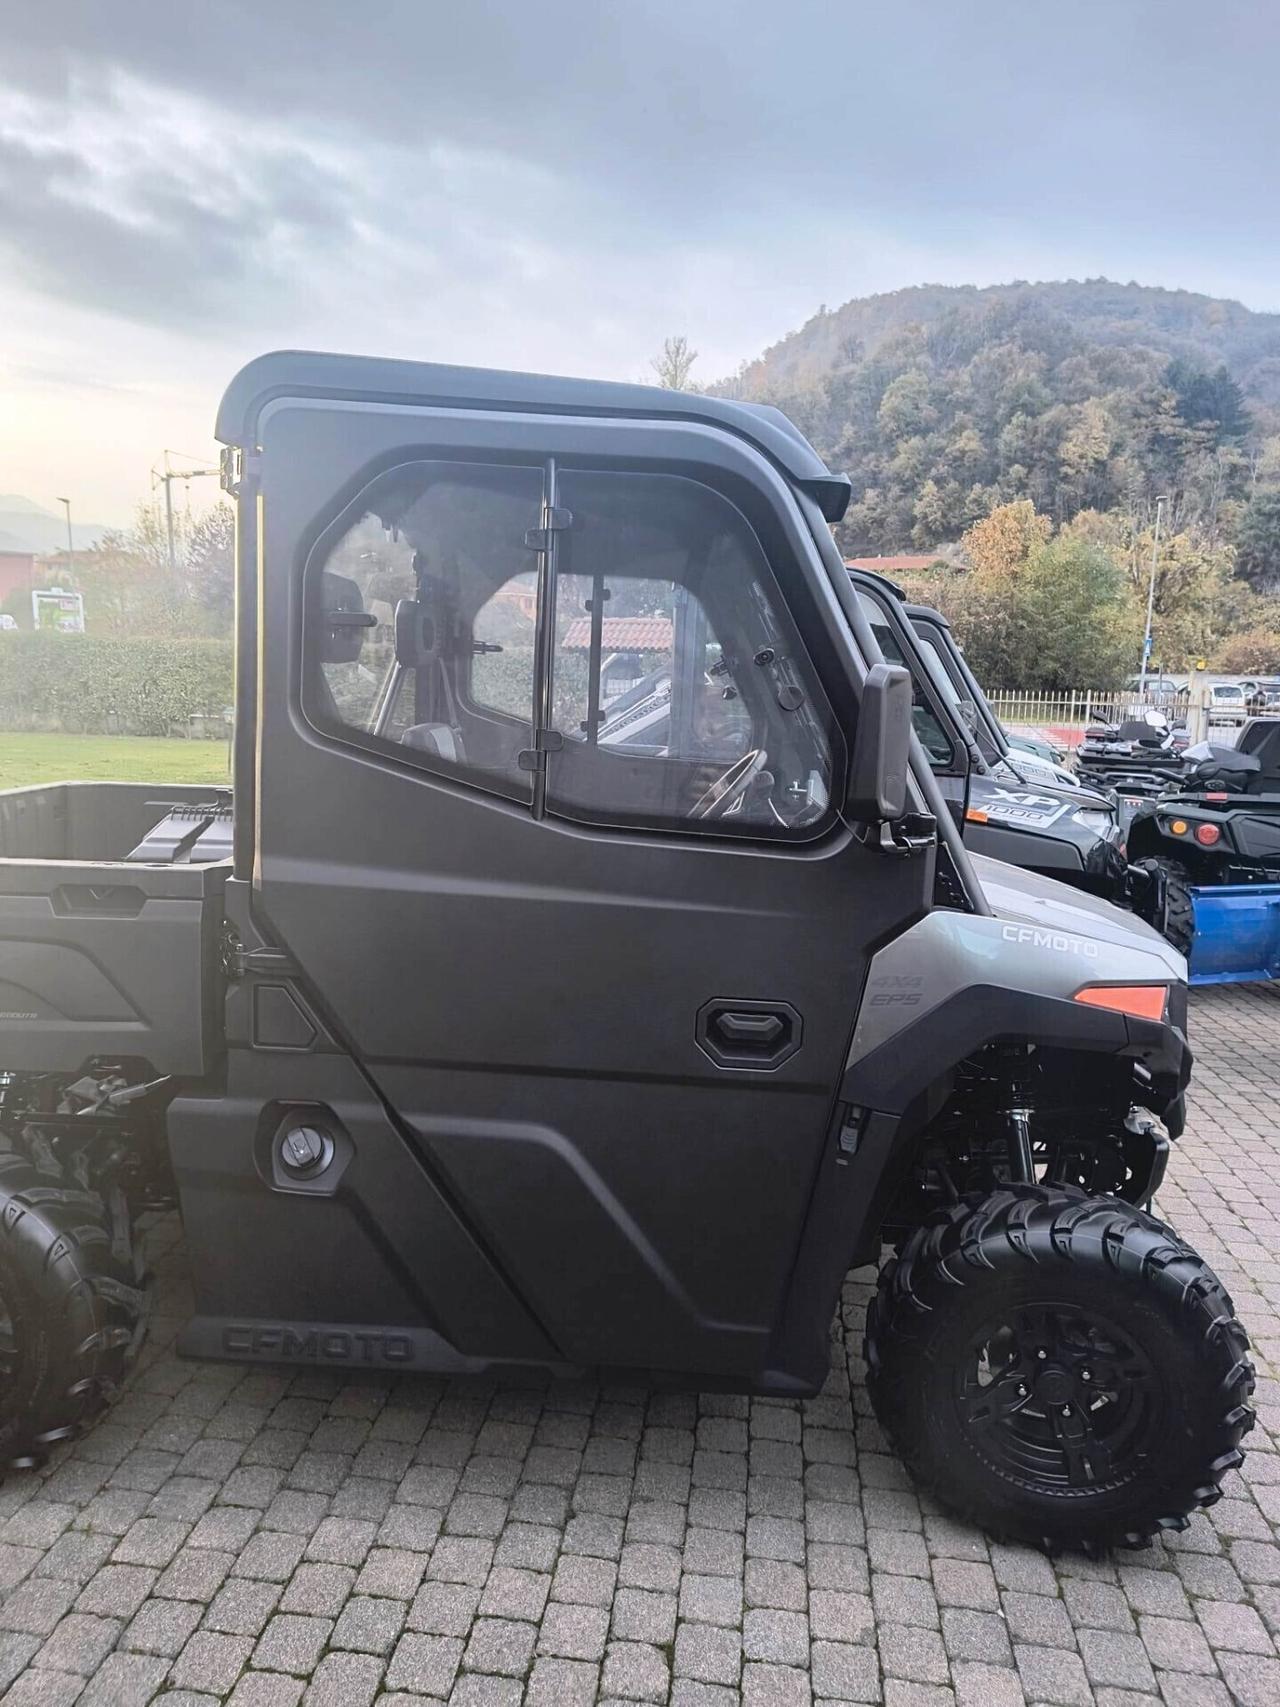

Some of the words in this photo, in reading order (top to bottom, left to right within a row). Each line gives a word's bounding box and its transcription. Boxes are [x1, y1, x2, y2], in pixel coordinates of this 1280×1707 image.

[983, 788, 1060, 805] XP
[985, 803, 1044, 820] 1000
[1002, 925, 1099, 958] CFMOTO
[869, 993, 924, 1006] EPS
[223, 1324, 415, 1361] CFMOTO
